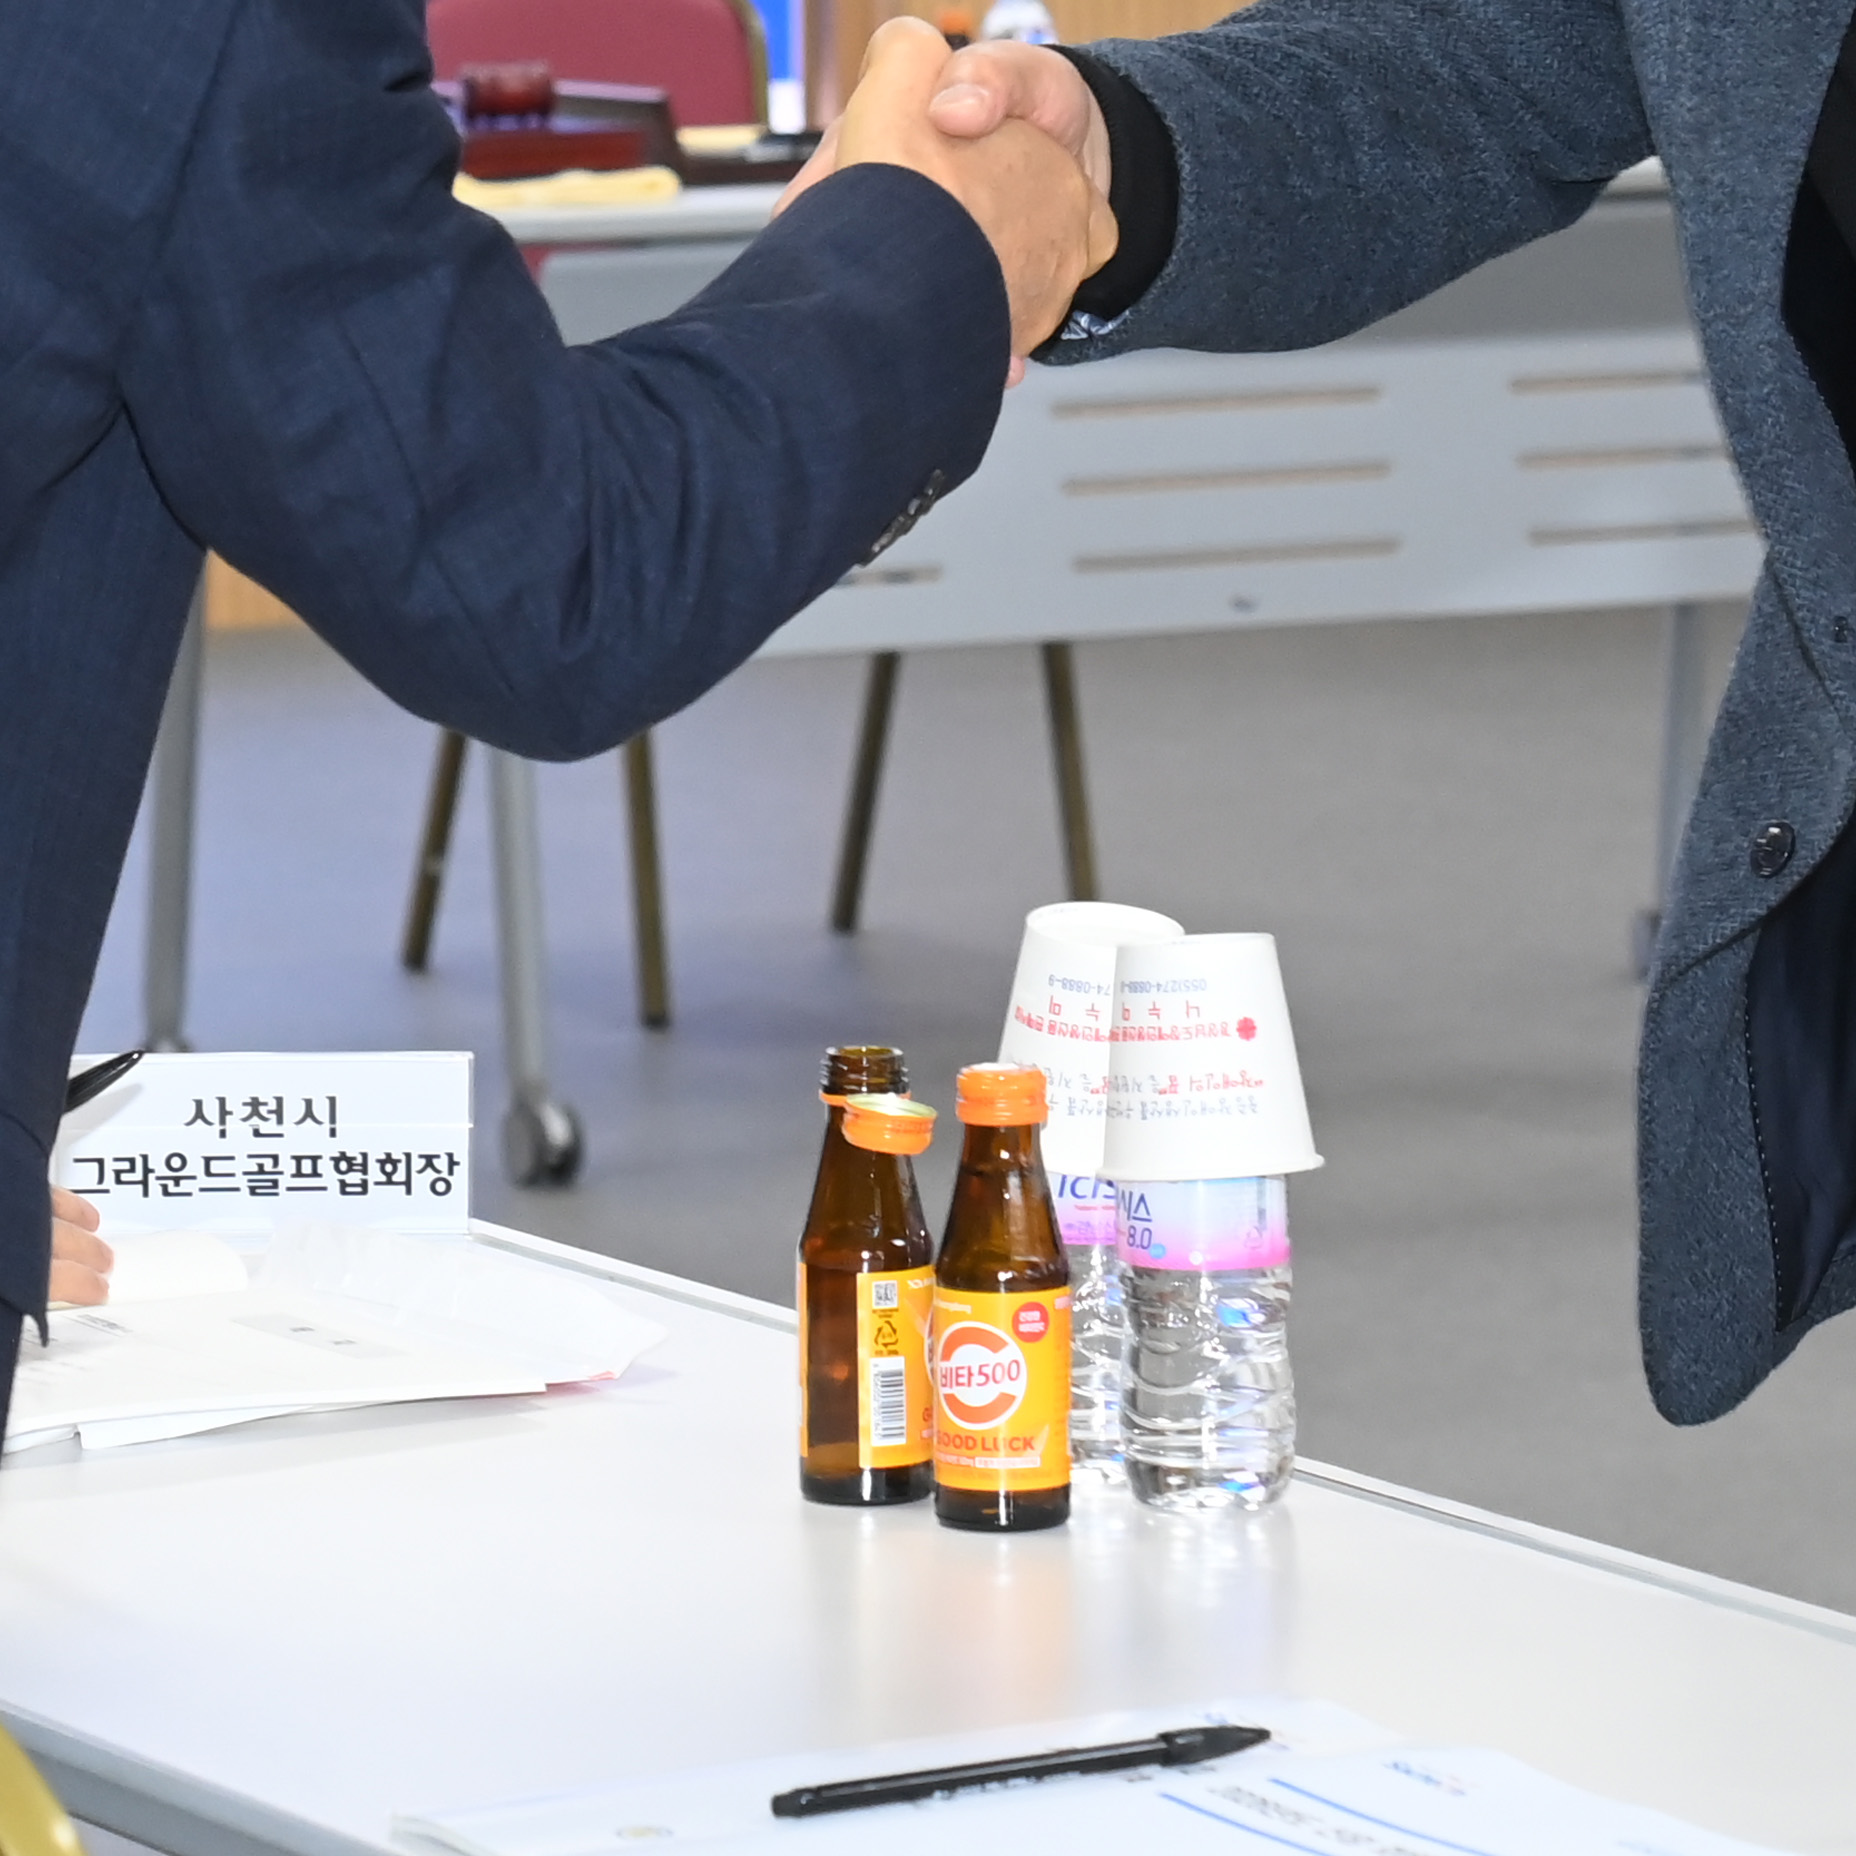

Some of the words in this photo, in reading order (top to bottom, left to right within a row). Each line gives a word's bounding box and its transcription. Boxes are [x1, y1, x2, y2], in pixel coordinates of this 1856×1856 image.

[184, 1095, 338, 1140] 사천시
[71, 1151, 461, 1199] 그라운드골프협회장
[1126, 1224, 1153, 1250] 8.0
[939, 1359, 1021, 1390] 비타500
